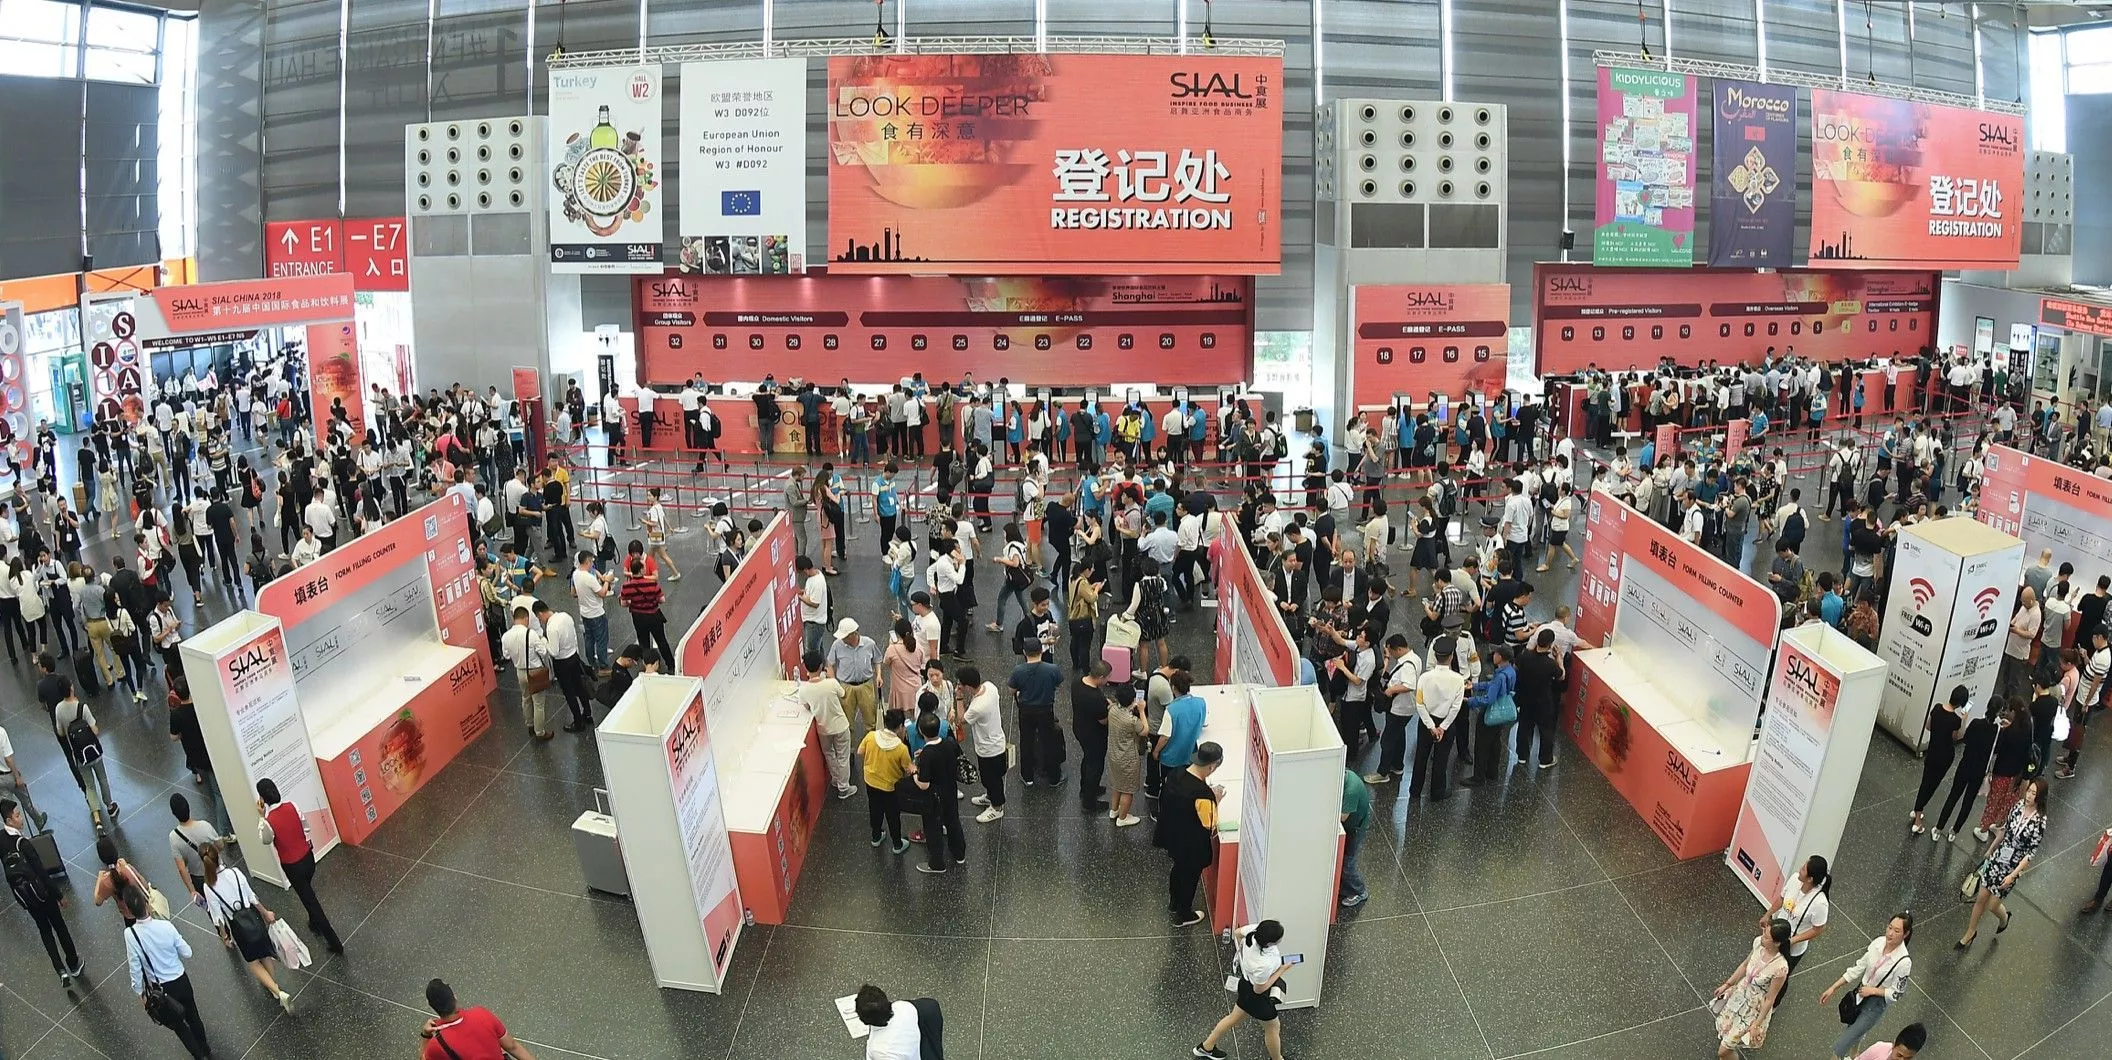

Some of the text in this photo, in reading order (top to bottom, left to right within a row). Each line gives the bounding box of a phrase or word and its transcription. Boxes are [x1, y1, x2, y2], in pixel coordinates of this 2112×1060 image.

[554, 76, 597, 88] Turkey
[1170, 73, 1252, 98] SIAL
[1616, 73, 1681, 88] KIDDYLICIOUS
[632, 83, 649, 98] W2
[711, 90, 773, 103] 欧盟荣誉地区
[1728, 87, 1789, 111] Morocco
[715, 107, 769, 117] W3 D092位
[836, 96, 1029, 117] LOOK DEEPER
[703, 130, 780, 141] European Union
[882, 123, 975, 140] 食有深意
[1816, 124, 1860, 142] LOOK
[1979, 123, 2012, 144] SIAL
[700, 144, 784, 155] Region of Honour
[715, 160, 768, 169] W3 #D092
[1052, 149, 1232, 203] 登记处
[1929, 176, 2003, 219] 登记处
[1052, 208, 1233, 230] REGISTRATION
[1929, 220, 2002, 238] REGISTRATION
[311, 226, 333, 252] E1
[374, 224, 402, 250] E7
[627, 245, 649, 254] SIAL
[273, 261, 334, 277] ENTRANCE
[366, 258, 404, 276] 入口
[652, 283, 691, 297] SIAL
[1551, 277, 1586, 291] SIAL
[212, 291, 281, 305] SIAL CHINA 2018
[1112, 292, 1156, 303] Shanghai
[1408, 292, 1447, 306] SIAL
[172, 298, 203, 313] SIAL
[1794, 324, 1798, 332] 6
[1816, 322, 1820, 330] 5
[1871, 321, 1875, 329] 3
[1892, 321, 1895, 329] 2
[152, 338, 182, 347] WELCOME
[671, 338, 680, 346] 32
[716, 338, 724, 346] 31
[752, 338, 761, 346] 30
[789, 339, 798, 347] 29
[874, 339, 884, 347] 27
[915, 339, 924, 347] 26
[956, 339, 965, 347] 25
[997, 339, 1007, 347] 24
[1038, 339, 1048, 347] 23
[1121, 338, 1131, 346] 21
[1380, 352, 1389, 360] 18
[1413, 351, 1422, 359] 17
[1477, 350, 1486, 358] 15
[100, 315, 138, 422] S I A L
[631, 410, 672, 427] SAL
[1661, 432, 1668, 452] 出口
[1732, 428, 1740, 447] 出口
[2054, 476, 2080, 496] 填表台
[294, 543, 396, 606] 填表台 FORM FILLING COUNTER
[1650, 538, 1743, 607] 填表台 FORM FILLING COUNTER
[1901, 611, 1931, 633] FREE Wi-Fi
[1964, 622, 1996, 637] FREE Wi-Fi
[315, 640, 335, 654] SIAL
[229, 646, 269, 680] SIAL
[449, 662, 473, 688] SIAL
[1734, 663, 1751, 685] SIAL
[1787, 655, 1820, 695] SIAL
[671, 716, 696, 763] SIAL
[1667, 750, 1690, 785] SIAL
